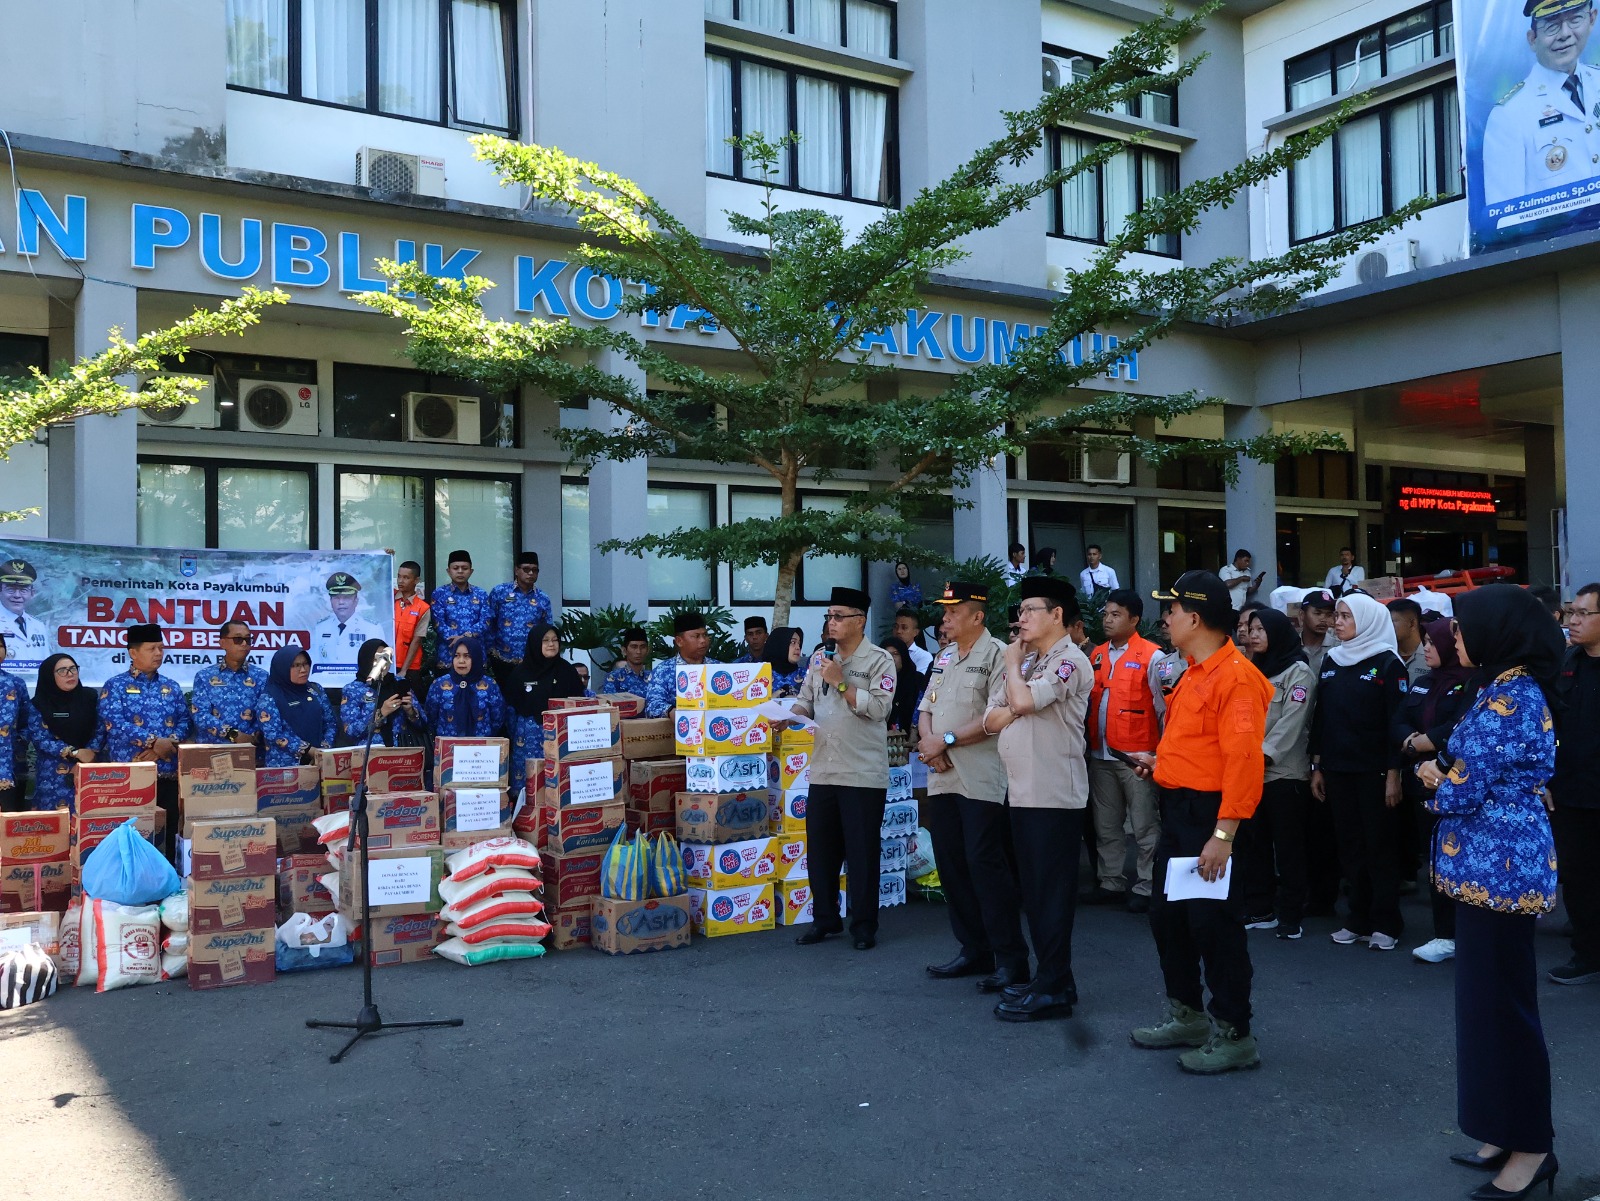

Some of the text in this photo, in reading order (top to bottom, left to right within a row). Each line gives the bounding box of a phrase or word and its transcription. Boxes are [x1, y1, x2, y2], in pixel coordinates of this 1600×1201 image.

[420, 159, 444, 167] SHARP
[1489, 208, 1503, 217] Dr.
[1504, 203, 1518, 213] dr.
[1519, 190, 1571, 210] Zulmaeta,
[130, 202, 484, 309] PUBLIK
[299, 401, 311, 409] LG
[1410, 498, 1418, 508] di
[1418, 498, 1436, 509] MPP
[1437, 499, 1456, 510] Kota
[81, 576, 290, 594] Pemerintah Kota Payakumbuh
[87, 596, 284, 627] BANTUAN
[192, 631, 304, 648] BEANA
[111, 652, 126, 664] di
[693, 767, 712, 778] Asri
[728, 760, 761, 778] Asri
[376, 804, 428, 818] Sedaap
[727, 802, 760, 823] Asri
[890, 809, 913, 824] Asri
[411, 832, 437, 841] GORENG
[384, 919, 438, 934] Sedaap
